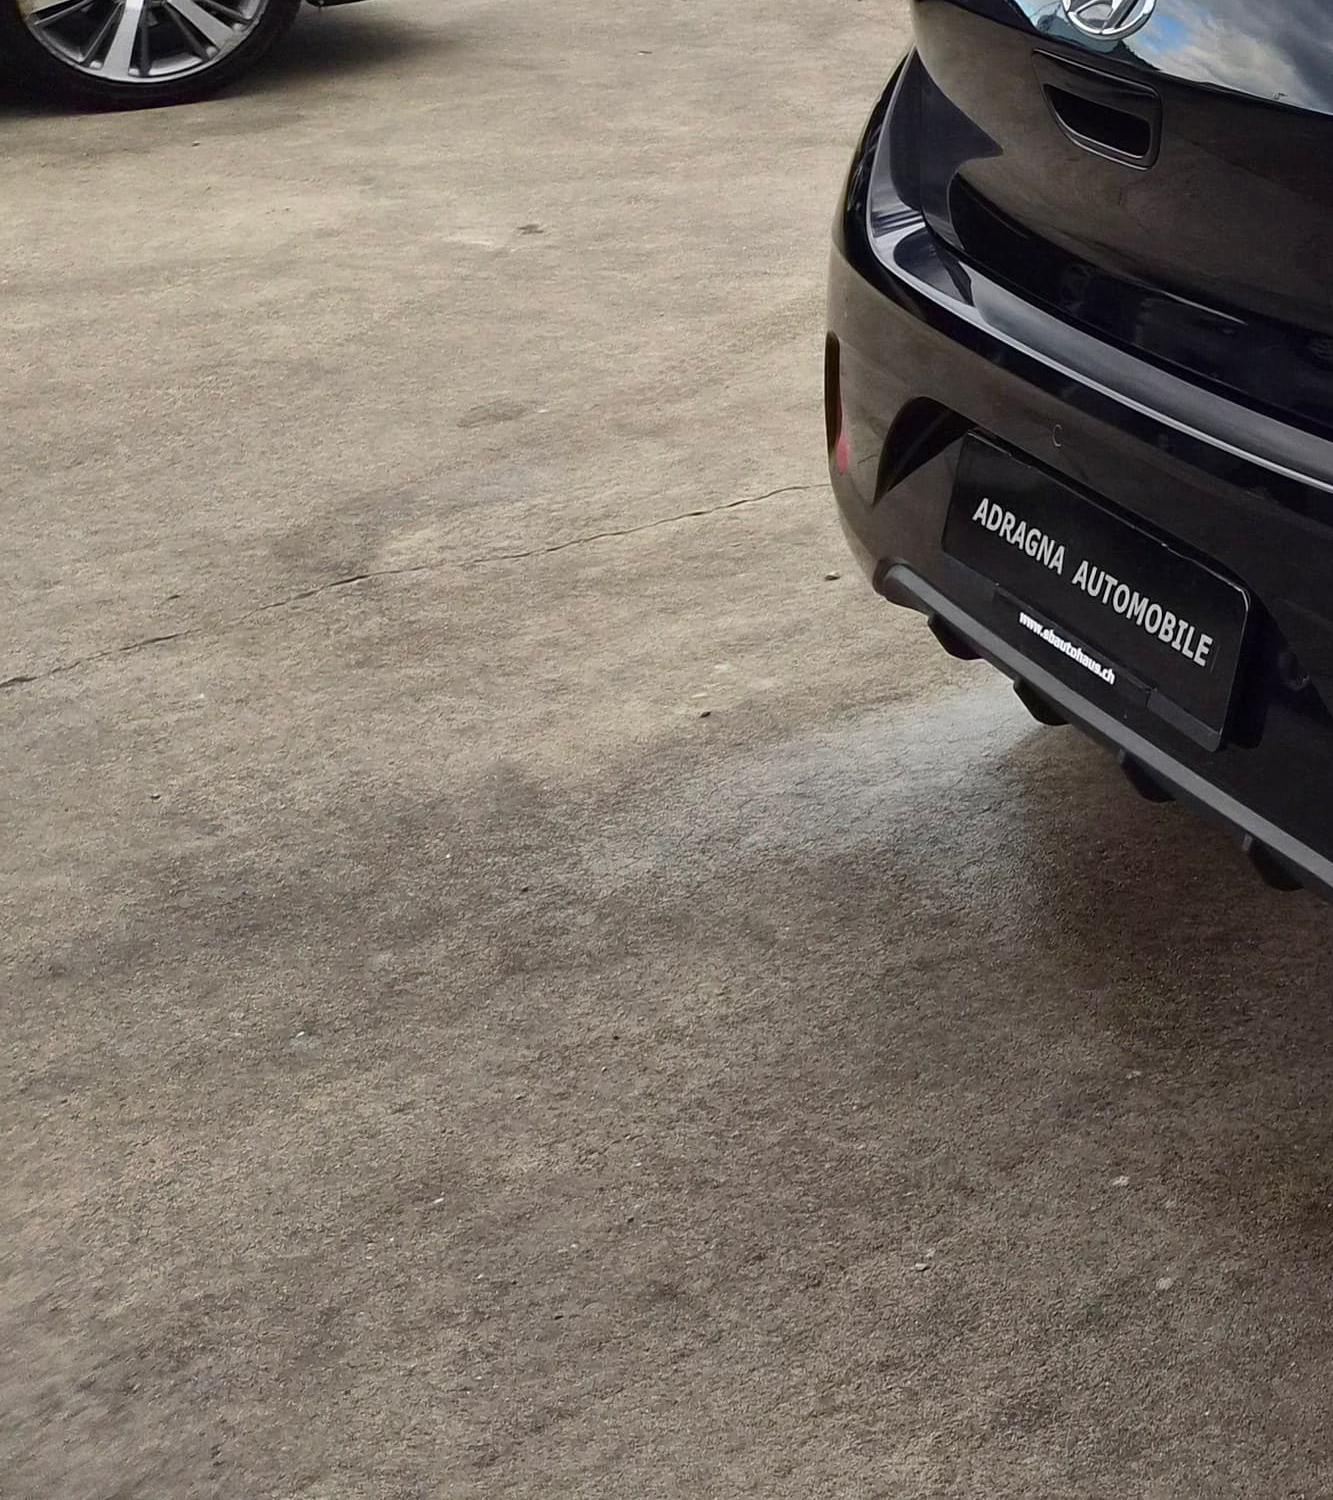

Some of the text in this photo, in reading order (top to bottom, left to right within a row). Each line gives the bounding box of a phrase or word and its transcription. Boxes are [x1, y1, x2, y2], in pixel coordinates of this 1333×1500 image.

[972, 498, 1213, 668] ADRAGNA AUTOMOBILE
[1019, 611, 1116, 685] www.sbautohaus.ch
